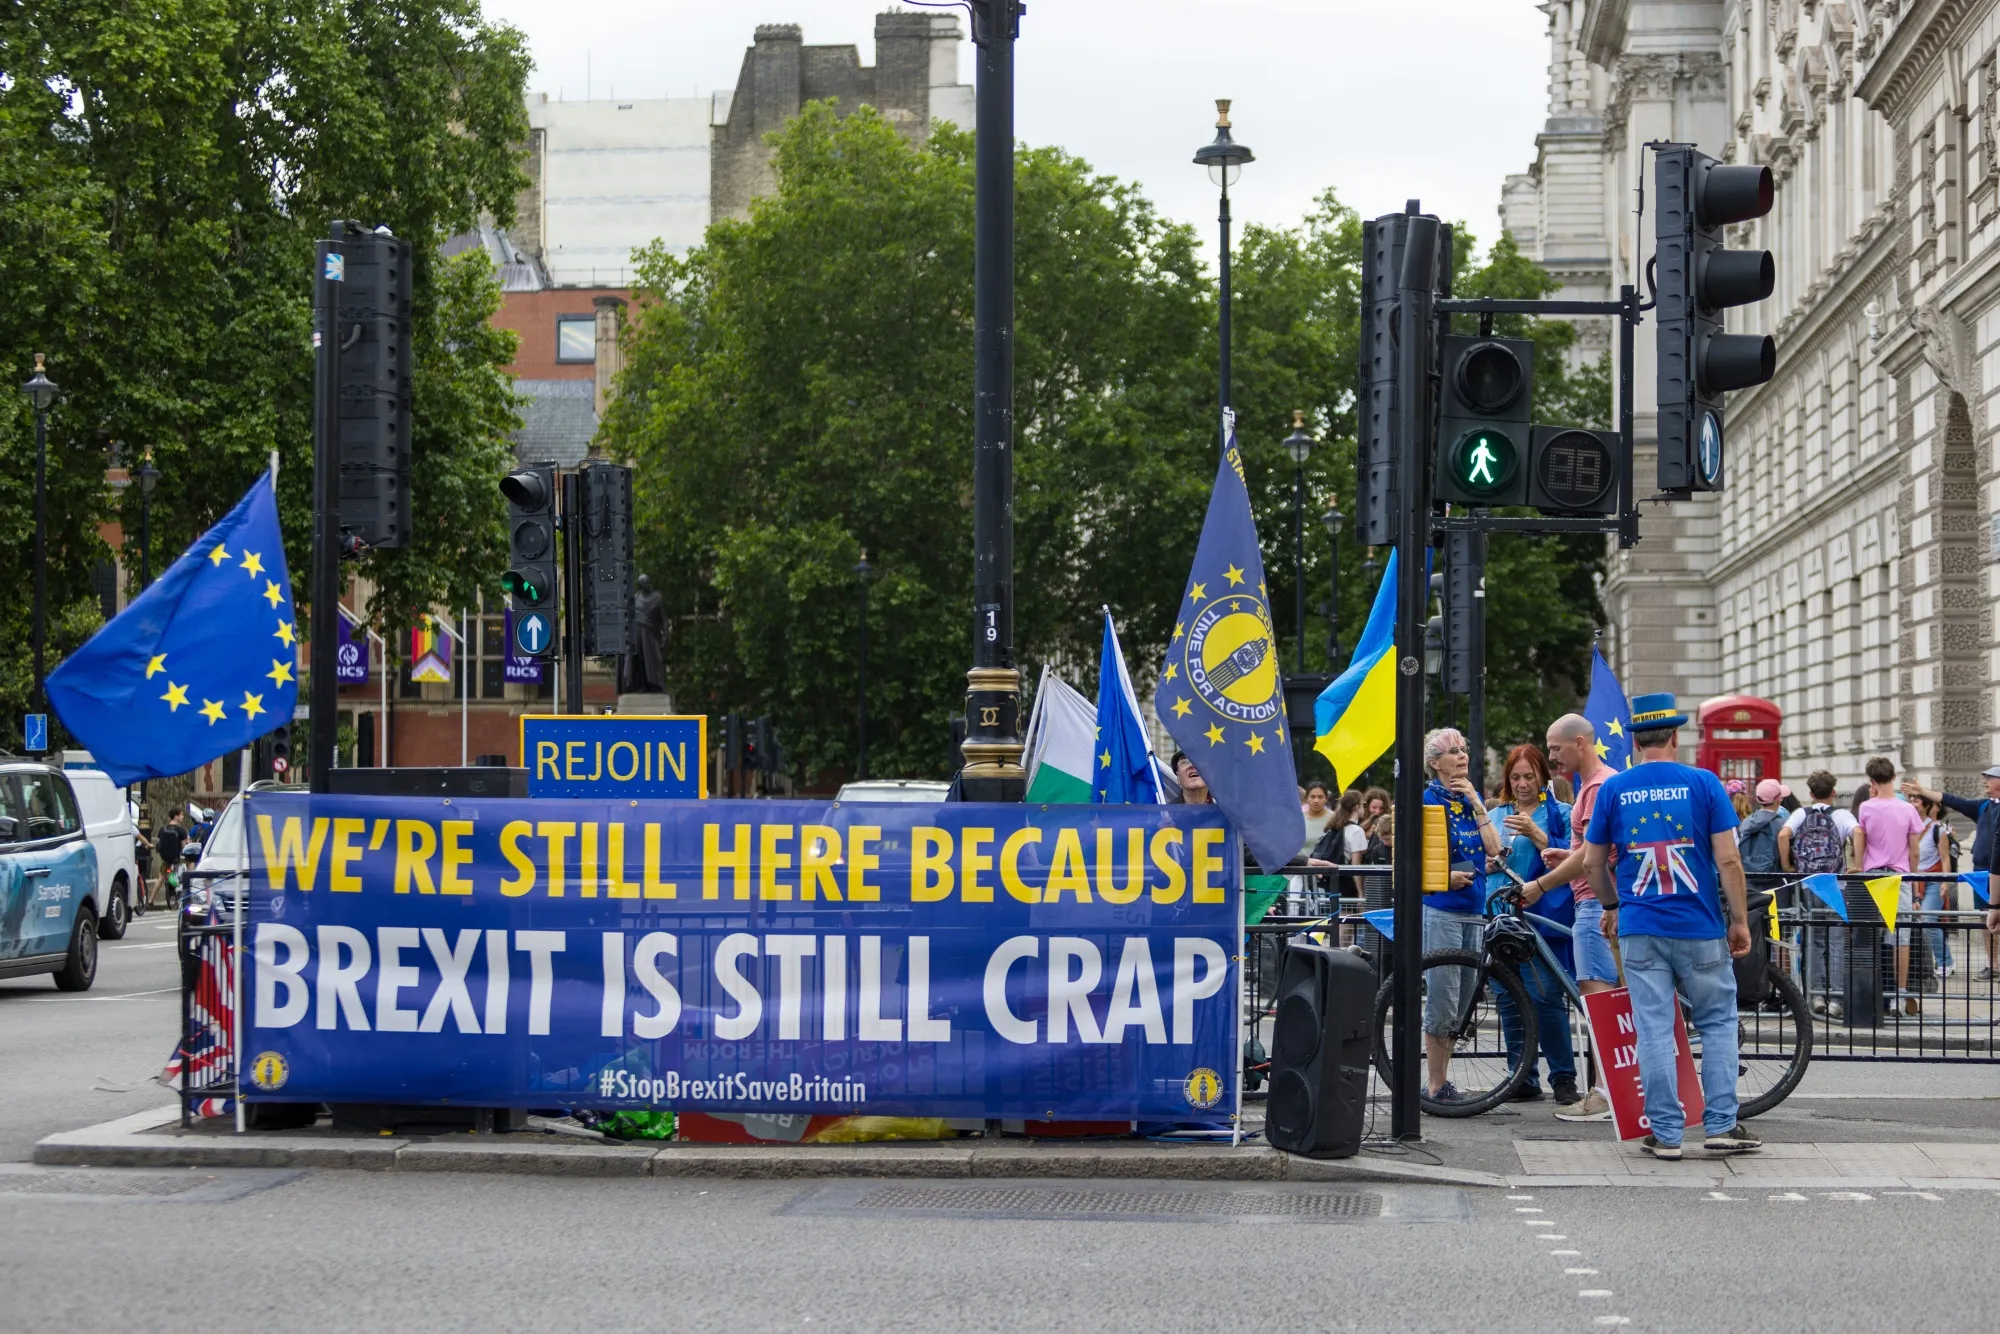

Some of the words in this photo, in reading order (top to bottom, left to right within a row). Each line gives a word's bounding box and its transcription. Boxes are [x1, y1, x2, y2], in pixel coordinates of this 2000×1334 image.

[1189, 610, 1220, 652] TIME
[507, 665, 538, 678] RICS
[1189, 658, 1214, 697] FOR
[1213, 697, 1276, 719] ACTION
[537, 741, 687, 783] REJOIN
[1620, 789, 1648, 806] STOP
[1650, 786, 1689, 802] BREXIT
[256, 815, 474, 895] WE'RE
[500, 821, 677, 900] STILL
[702, 823, 882, 902] HERE
[911, 826, 1225, 905] BECAUSE
[255, 922, 566, 1036] BREXIT
[601, 931, 682, 1039] IS
[714, 932, 951, 1043] STILL
[983, 935, 1228, 1045] CRAP
[599, 1068, 867, 1105] #StopBrexitSaveBritain
